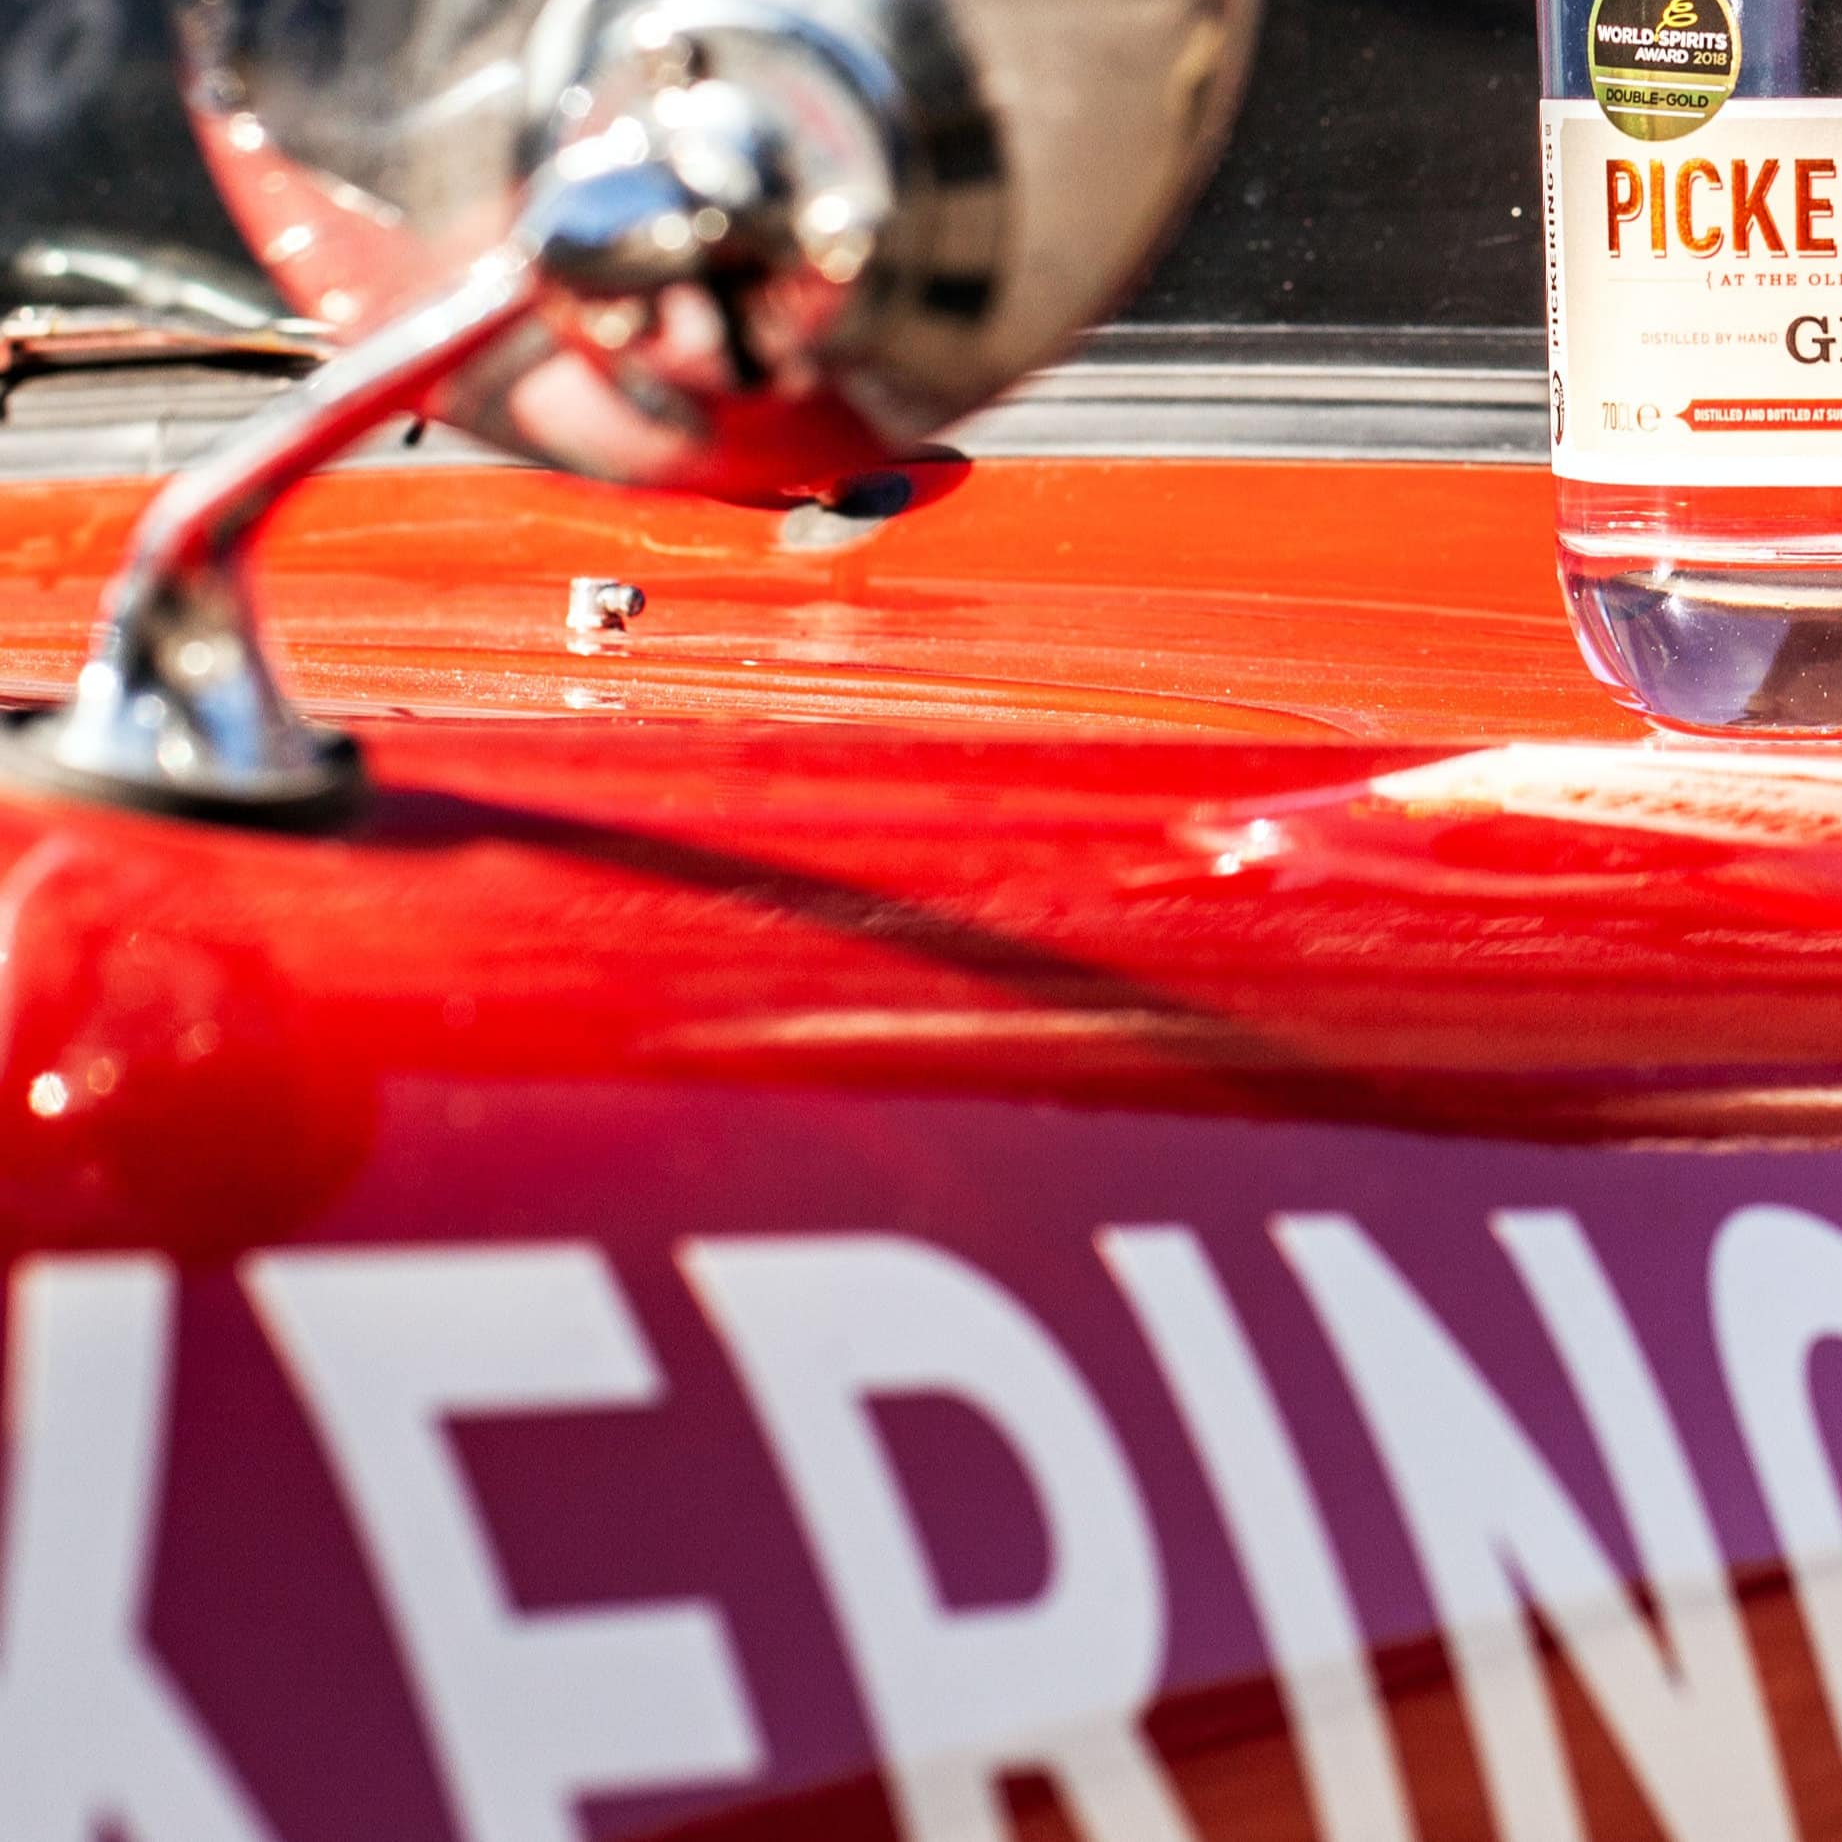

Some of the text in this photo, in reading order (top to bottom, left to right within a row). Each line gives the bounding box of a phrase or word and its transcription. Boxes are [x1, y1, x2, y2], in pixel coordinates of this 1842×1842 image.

[1597, 24, 1728, 50] WORLD SPIRITS
[1634, 47, 1728, 66] AWARD 2018
[1606, 88, 1709, 108] DOUBLE-GOLD
[1720, 273, 1745, 287] AT
[1755, 273, 1798, 287] THE
[1641, 332, 1778, 345] DISTILLED BY HAND
[1694, 407, 1743, 422] DISTILLED
[1744, 407, 1766, 422] AND
[1767, 407, 1811, 422] BOTTLED
[1812, 407, 1827, 422] AT
